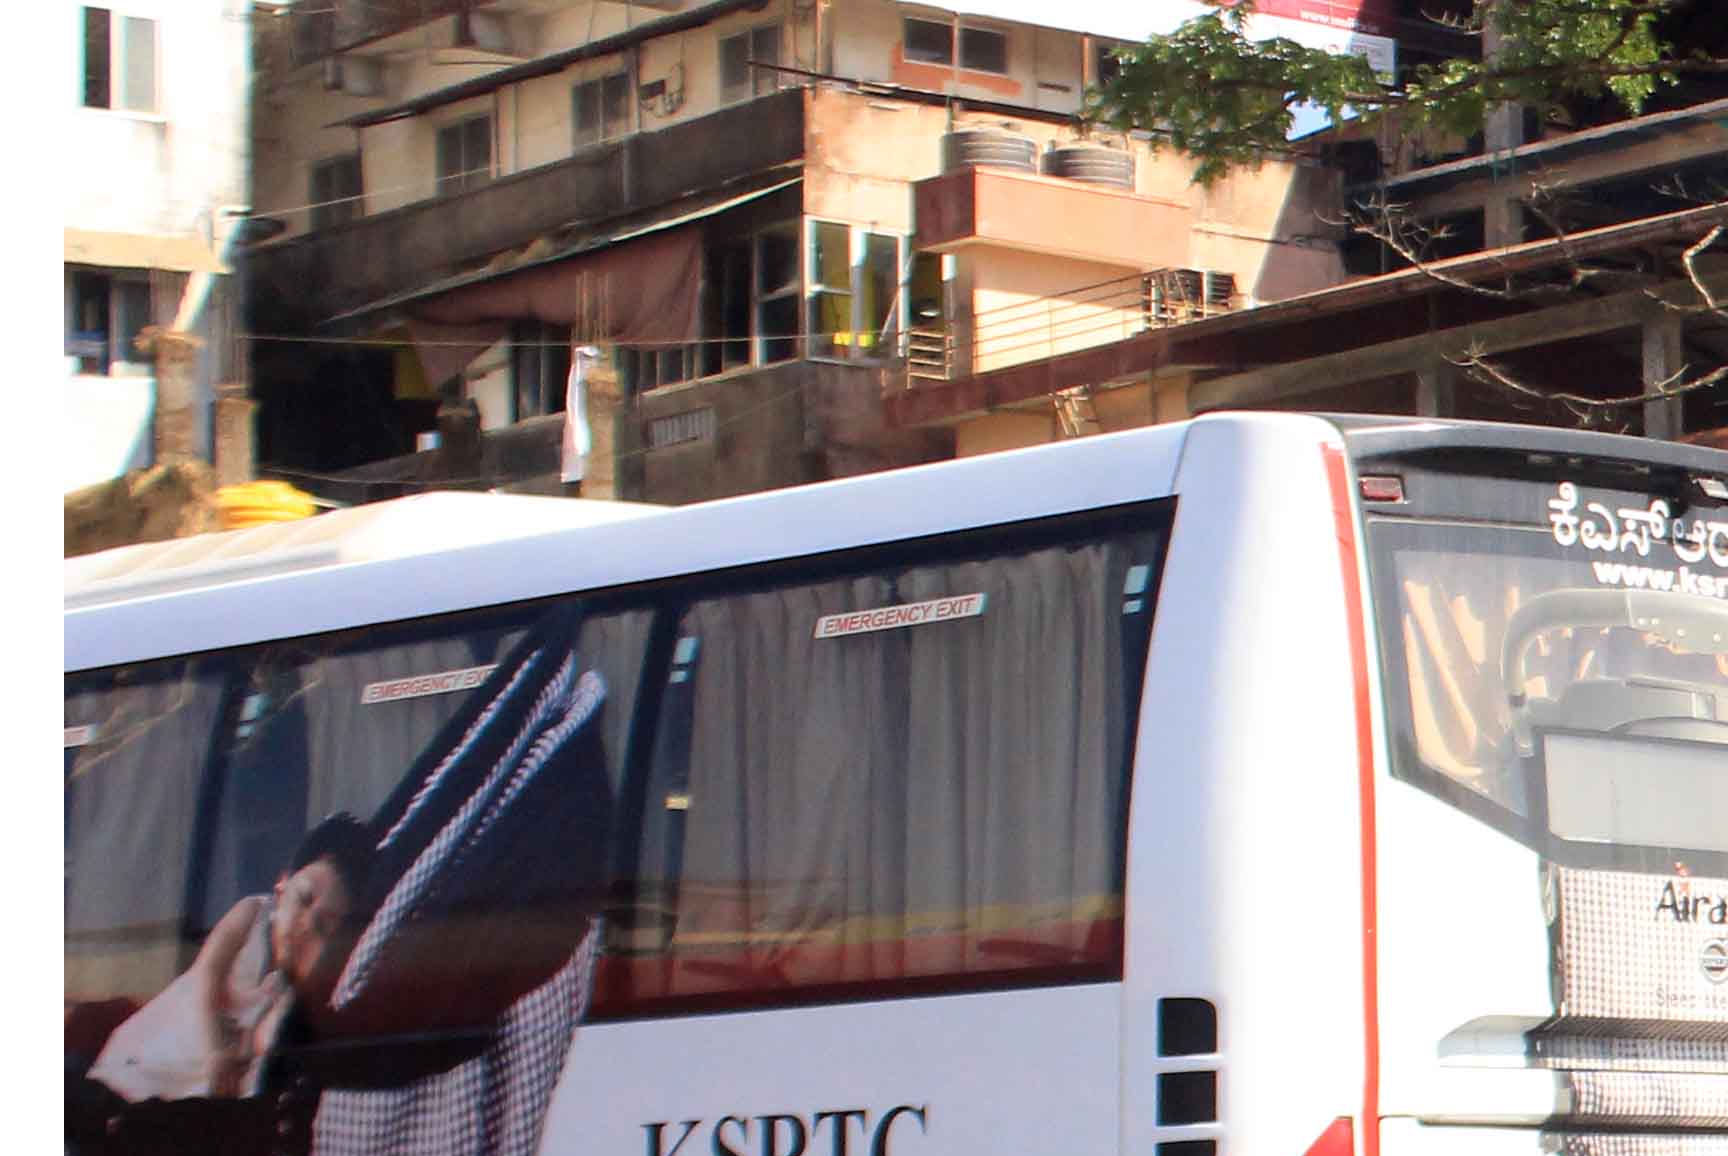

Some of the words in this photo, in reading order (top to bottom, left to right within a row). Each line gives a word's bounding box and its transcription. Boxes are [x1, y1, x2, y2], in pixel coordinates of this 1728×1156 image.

[823, 601, 932, 635] EMERGENCY
[936, 596, 976, 617] EXIT
[369, 675, 457, 699] EMERGENCY
